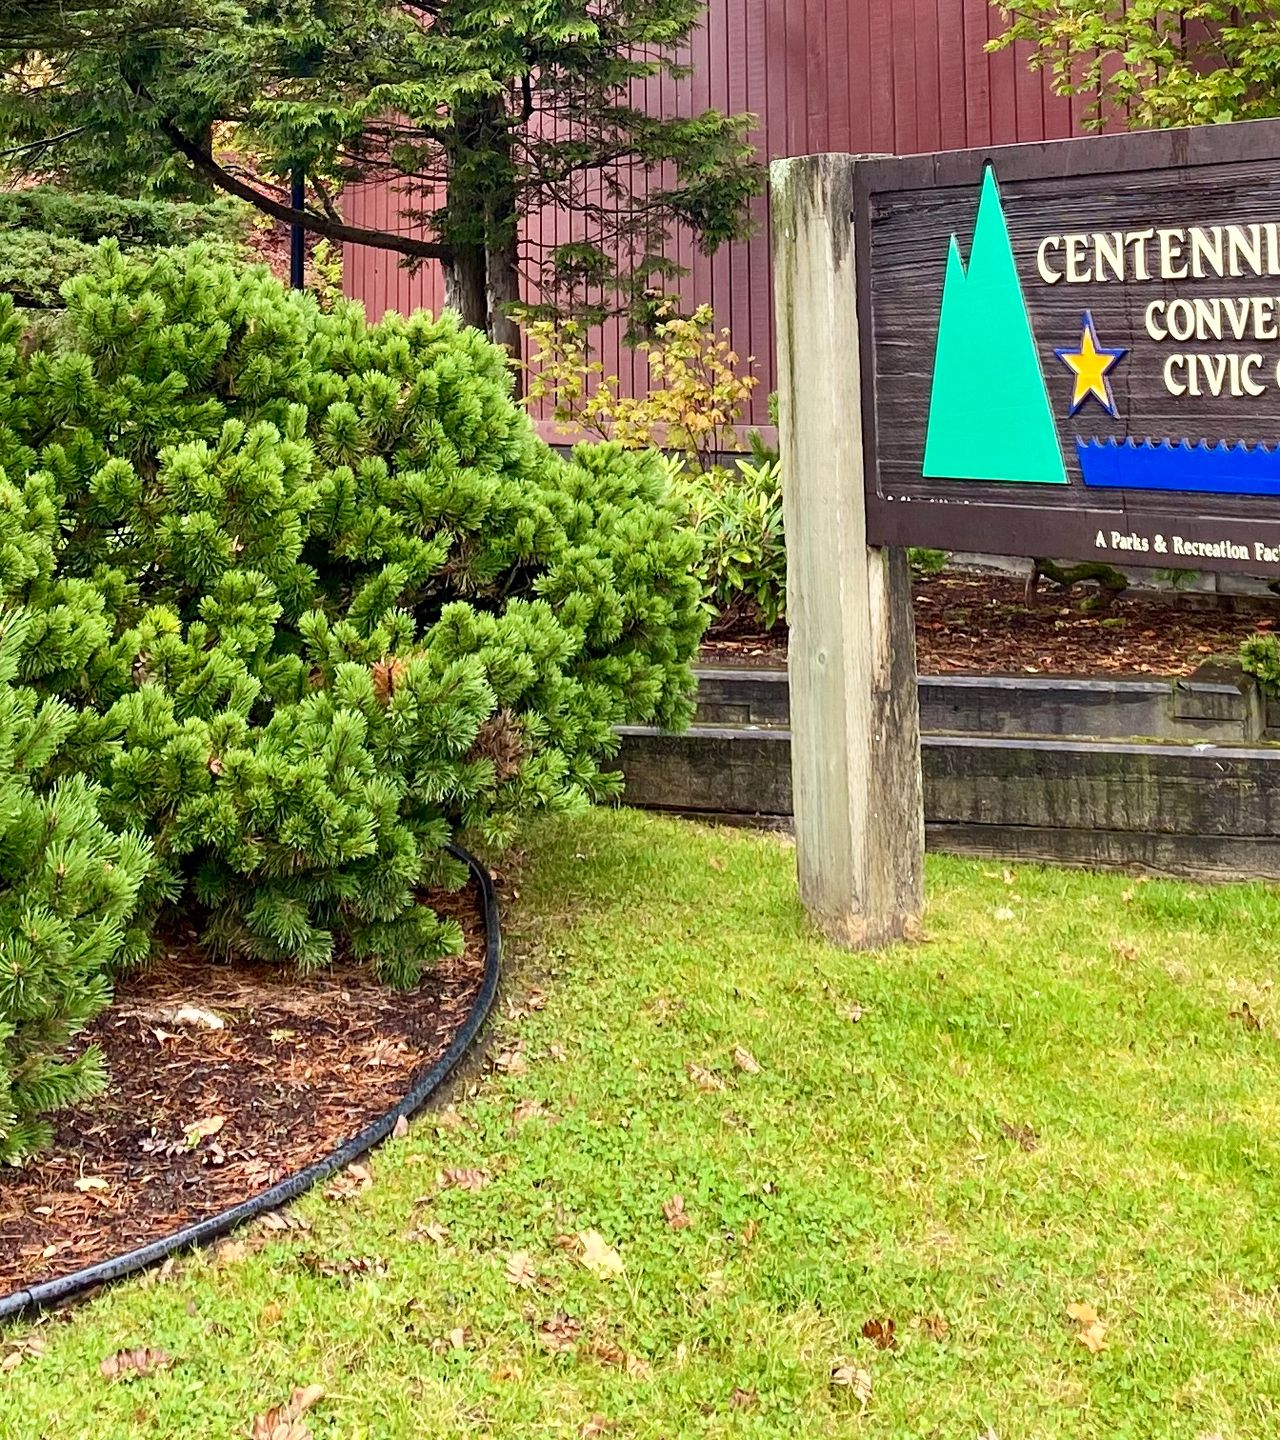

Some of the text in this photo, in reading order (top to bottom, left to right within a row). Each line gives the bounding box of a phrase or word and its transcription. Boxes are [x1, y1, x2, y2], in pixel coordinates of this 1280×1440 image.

[1163, 353, 1267, 397] CIVIC
[1095, 530, 1107, 548] A
[1110, 530, 1150, 553] Parks
[1153, 534, 1169, 554] &
[1171, 536, 1250, 560] Recreation
